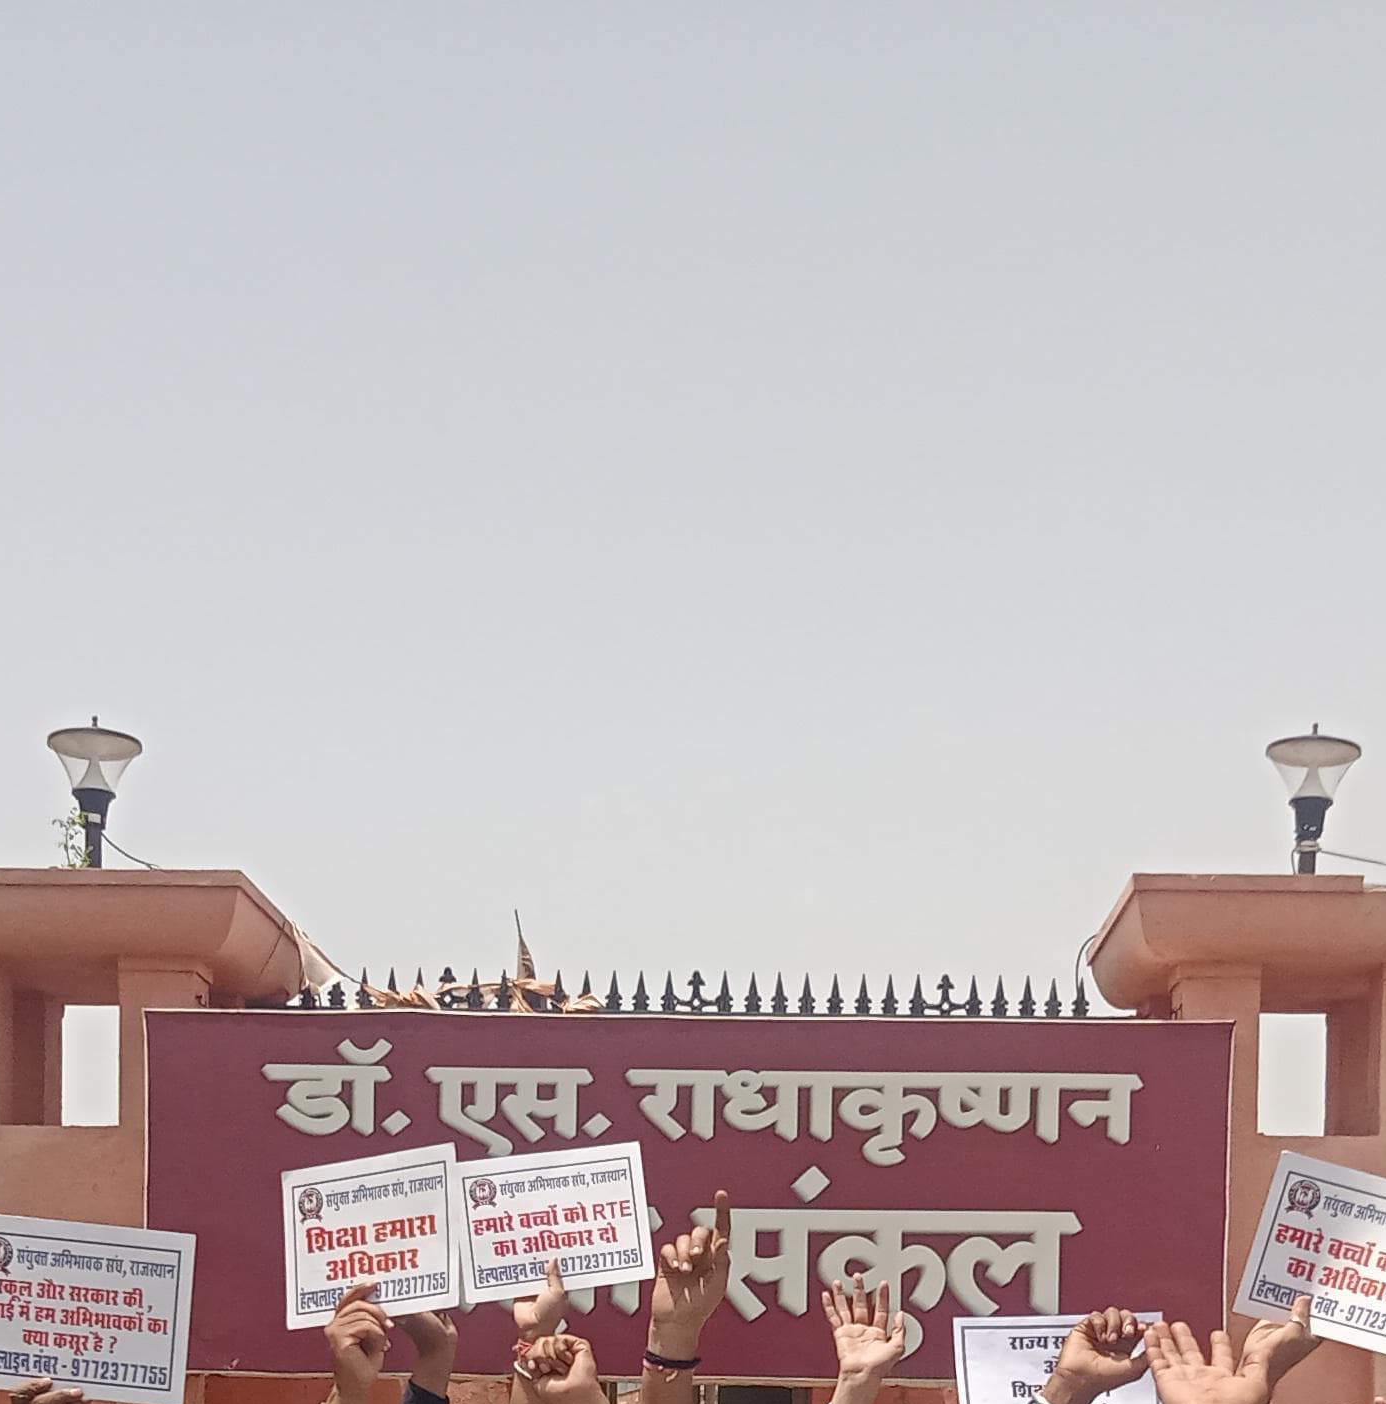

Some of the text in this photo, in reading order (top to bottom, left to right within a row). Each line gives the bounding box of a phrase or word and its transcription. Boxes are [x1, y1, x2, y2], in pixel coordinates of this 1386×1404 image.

[263, 1037, 1143, 1167] डॉ. एस. राधाकृष्णन
[305, 1214, 437, 1253] शिक्षा हमारा
[471, 1199, 632, 1235] हमारे बच्चों को RTE
[491, 1221, 618, 1257] का अधिकार दो
[1274, 1222, 1324, 1253] हमारे
[1327, 1237, 1376, 1267] बच्चों
[325, 1248, 418, 1281] अधिकार
[476, 1248, 638, 1287] हेल्पलाइन 9772377755
[1286, 1256, 1315, 1282] का
[36, 1278, 65, 1300] और
[68, 1285, 118, 1306] सरकार
[122, 1287, 143, 1308] की
[17, 1298, 31, 1321] में
[34, 1306, 55, 1323] हम
[59, 1306, 144, 1332] अभिभावकों
[147, 1317, 167, 1335] का
[21, 1328, 49, 1347] क्या
[52, 1332, 89, 1356] कसूर
[1008, 1335, 1048, 1349] राज्य
[32, 1348, 58, 1374] नंबर
[70, 1357, 167, 1385] 9772377755
